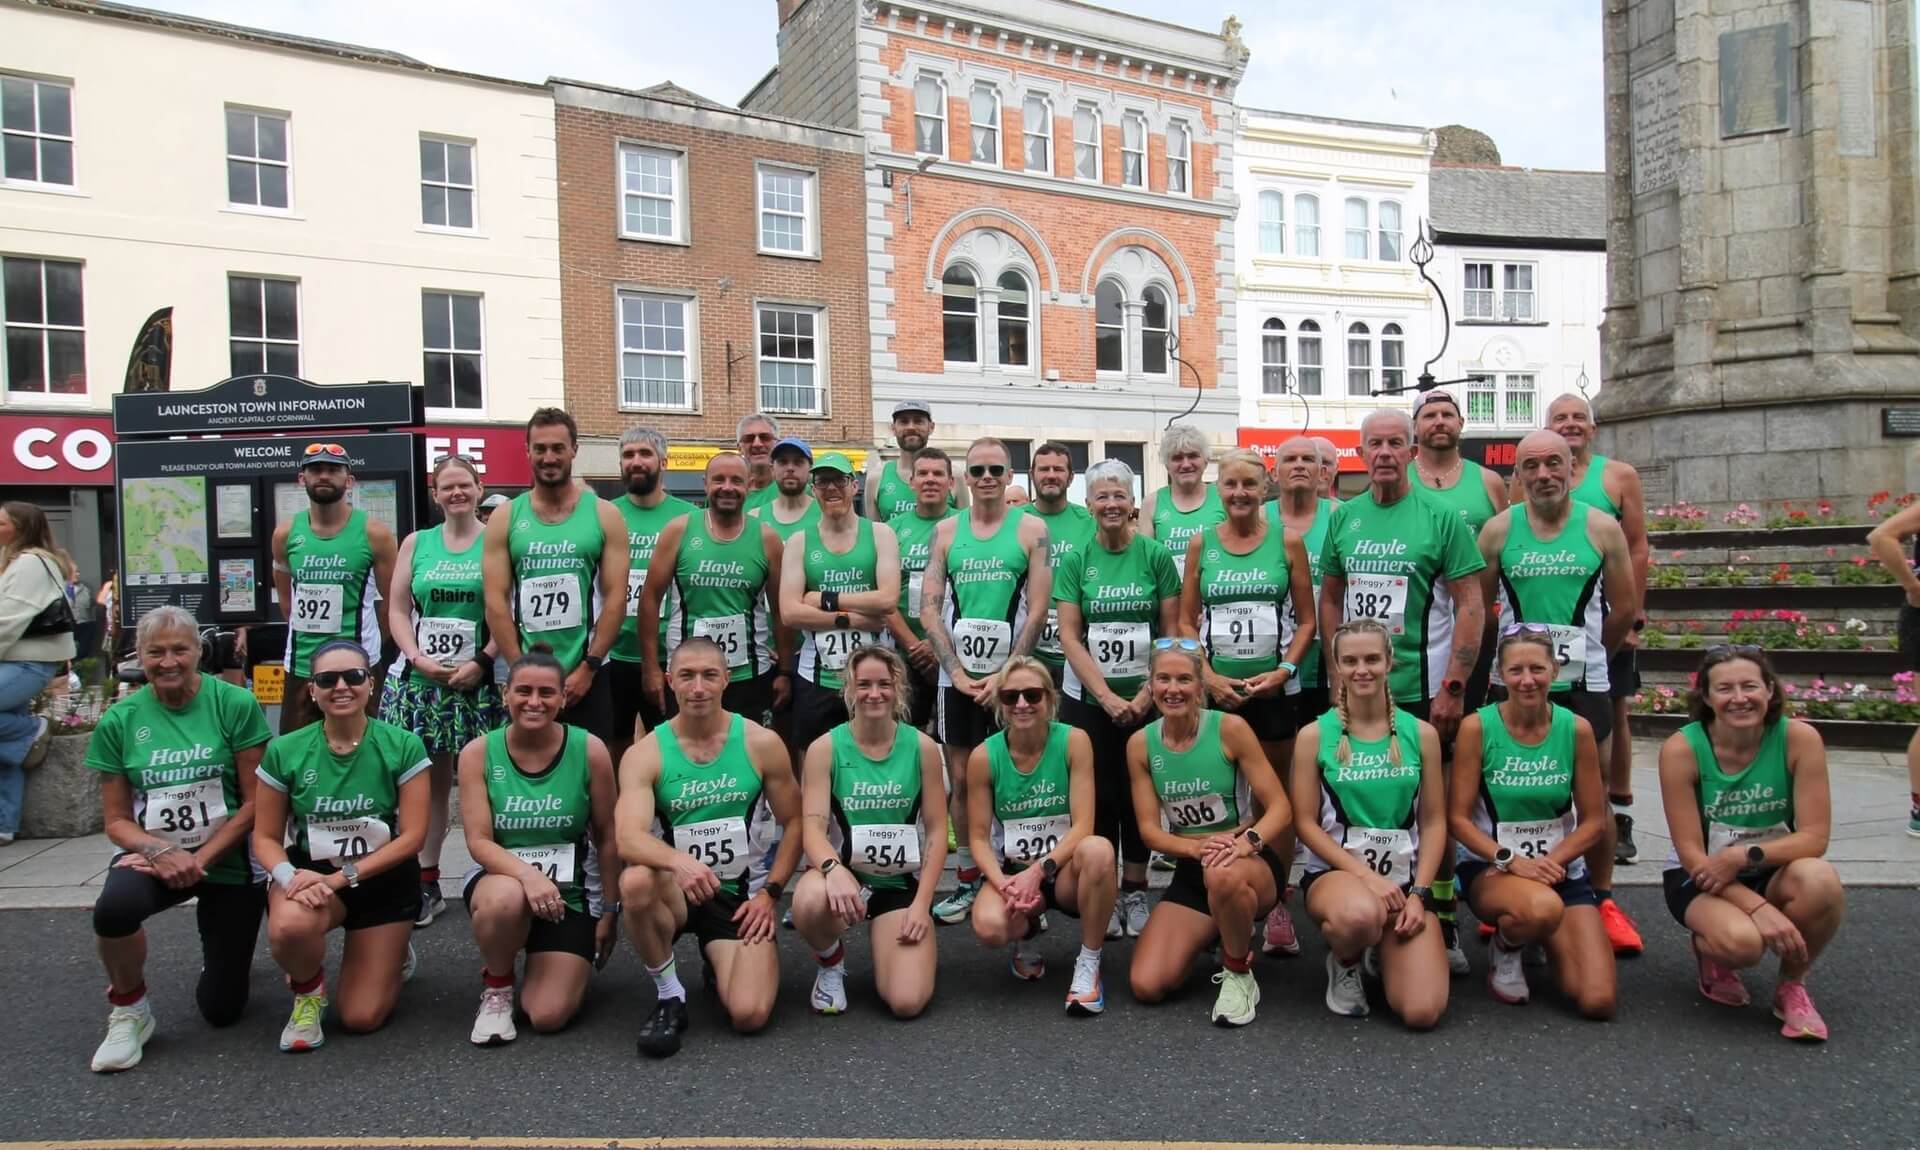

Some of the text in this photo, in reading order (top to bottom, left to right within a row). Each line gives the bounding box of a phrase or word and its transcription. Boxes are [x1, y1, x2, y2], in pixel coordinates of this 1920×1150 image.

[158, 398, 366, 416] LAUNCESTON TOWN INFORMATION
[208, 414, 315, 424] ANCIENT CAPITAL OF CORNWALL
[234, 446, 291, 457] WELCOME
[161, 464, 185, 472] PLEASE
[209, 463, 224, 471] OUR
[225, 462, 246, 470] TOWN
[247, 461, 262, 469] AND
[280, 460, 295, 468] OUR
[527, 540, 577, 556] Hayle
[1353, 539, 1407, 558] Hayle
[302, 555, 347, 571] Hayle
[521, 557, 585, 570] Runners
[963, 557, 1004, 573] Hayle
[1345, 557, 1416, 573] Runners
[1519, 550, 1576, 565] Hayle
[434, 560, 479, 573] Hayle
[699, 560, 744, 575] Hayle
[1511, 565, 1587, 578] Runners
[296, 569, 354, 581] Runners
[690, 574, 752, 589] Runners
[824, 568, 863, 584] Hayle
[956, 571, 1013, 584] Runners
[1215, 568, 1267, 584] Hayle
[532, 580, 558, 589] Treggy
[1096, 583, 1143, 600] Hayle
[1207, 584, 1279, 597] Runners
[1358, 578, 1385, 589] Treggy
[430, 589, 476, 603] Claire
[297, 599, 331, 620] 392
[530, 592, 570, 617] 279
[1090, 600, 1152, 614] Runners
[1225, 608, 1253, 616] Treggy
[1355, 592, 1392, 619] 382
[429, 622, 456, 630] Treggy
[705, 622, 730, 630] Treggy
[967, 623, 991, 631] Treggy
[1102, 627, 1128, 635] Treggy
[1229, 620, 1254, 643] 91
[426, 634, 463, 655] 389
[825, 632, 862, 656] 218
[962, 635, 1000, 659] 307
[1098, 640, 1135, 663] 391
[149, 744, 213, 766] Hayle
[1502, 755, 1558, 775] Hayle
[141, 764, 225, 786] Runners
[1336, 766, 1415, 782] Runners
[1490, 770, 1568, 786] Runners
[680, 774, 737, 798] Hayle
[851, 781, 902, 798] Hayle
[1164, 778, 1211, 795] Hayle
[164, 789, 197, 800] Treggy
[671, 791, 749, 811] Runners
[1713, 783, 1774, 806] Hayle
[312, 794, 375, 814] Hayle
[503, 794, 562, 815] Hayle
[843, 797, 911, 811] Runners
[1704, 798, 1787, 819] Runners
[160, 801, 209, 832] 381
[495, 814, 574, 829] Runners
[1172, 801, 1216, 826] 306
[327, 824, 361, 832] Treggy
[689, 826, 721, 837] Treggy
[869, 830, 897, 839] Treggy
[1018, 822, 1048, 831] Treggy
[1515, 826, 1545, 835] Treggy
[333, 836, 368, 857] 70
[1363, 832, 1392, 845] Treggy
[518, 850, 550, 858] Treggy
[864, 845, 907, 868] 354
